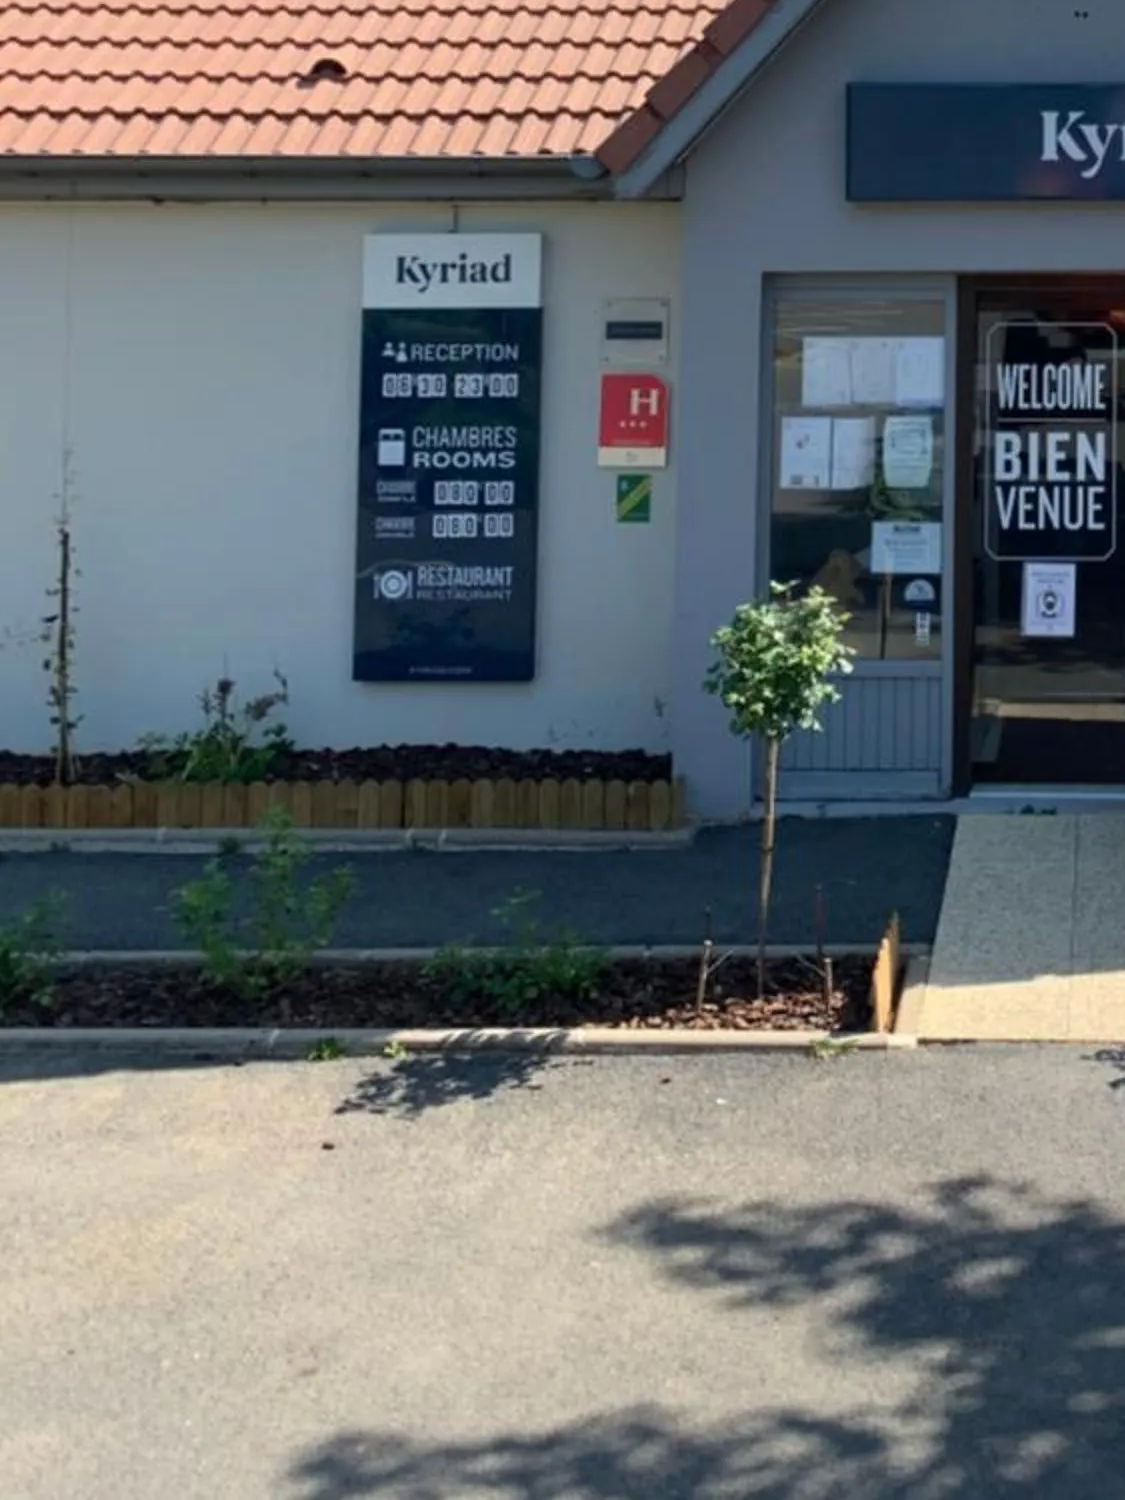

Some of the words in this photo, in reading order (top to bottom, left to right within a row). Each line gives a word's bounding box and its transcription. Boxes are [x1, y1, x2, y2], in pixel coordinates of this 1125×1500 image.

[396, 253, 512, 293] Kyriad
[410, 343, 519, 361] RECEPTION
[997, 363, 1107, 410] WELCOME
[412, 426, 518, 448] CHAMBRES
[412, 451, 516, 469] ROOMS
[995, 431, 1106, 482] BIEN
[995, 485, 1106, 530] VENUE
[416, 565, 514, 588] RESTAURANT
